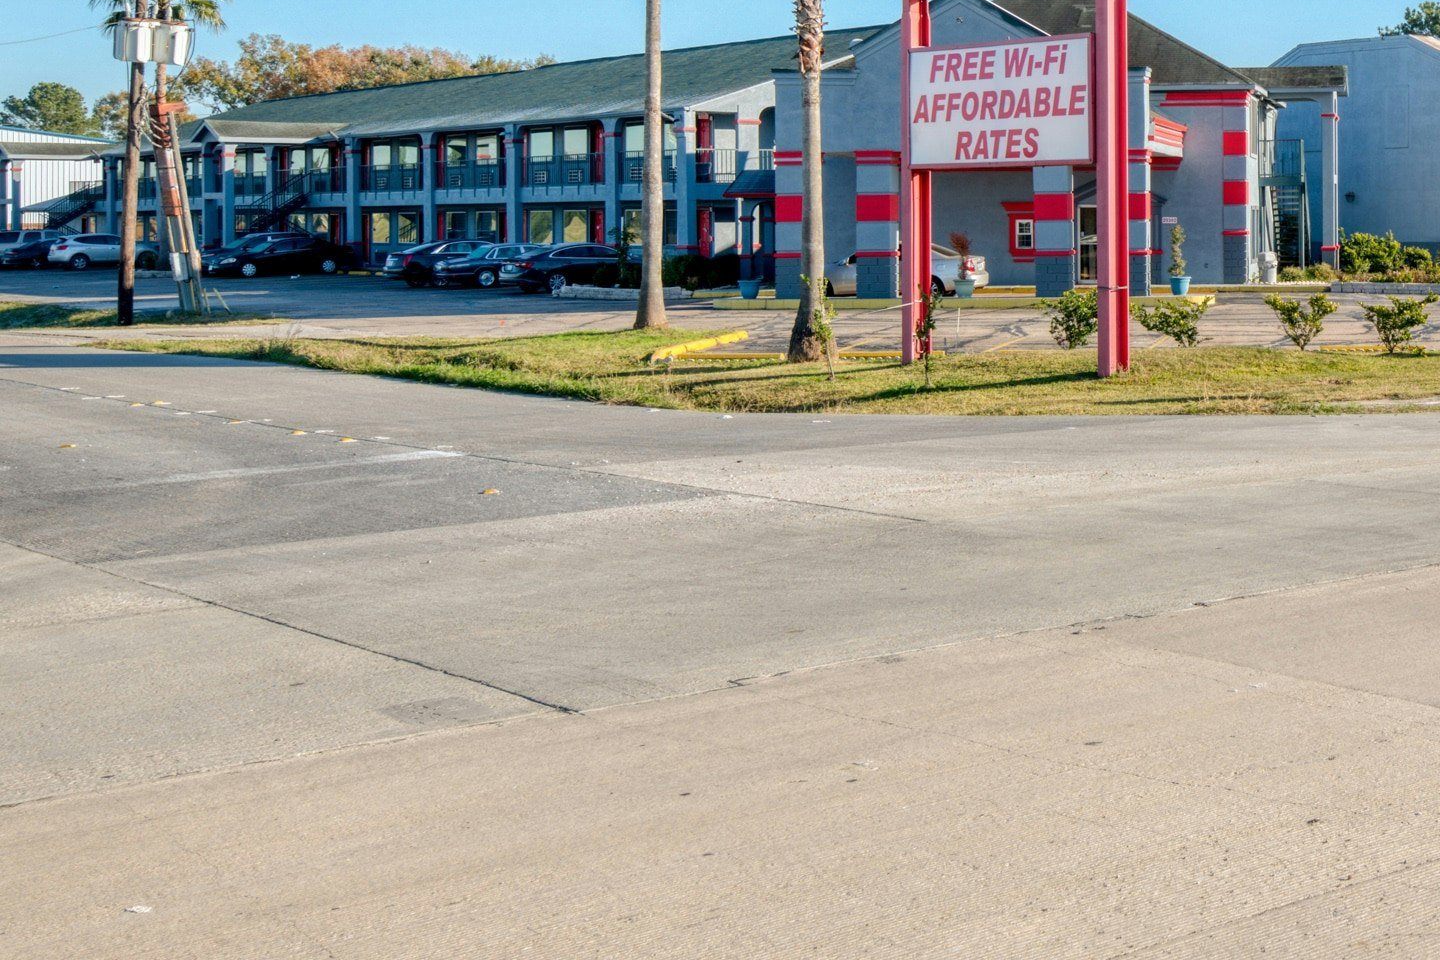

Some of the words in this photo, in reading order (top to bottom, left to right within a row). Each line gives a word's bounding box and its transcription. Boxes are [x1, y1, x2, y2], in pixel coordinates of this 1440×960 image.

[929, 50, 996, 83] FREE
[913, 85, 1086, 124] AFFORDABLE
[955, 127, 1039, 160] RATES
